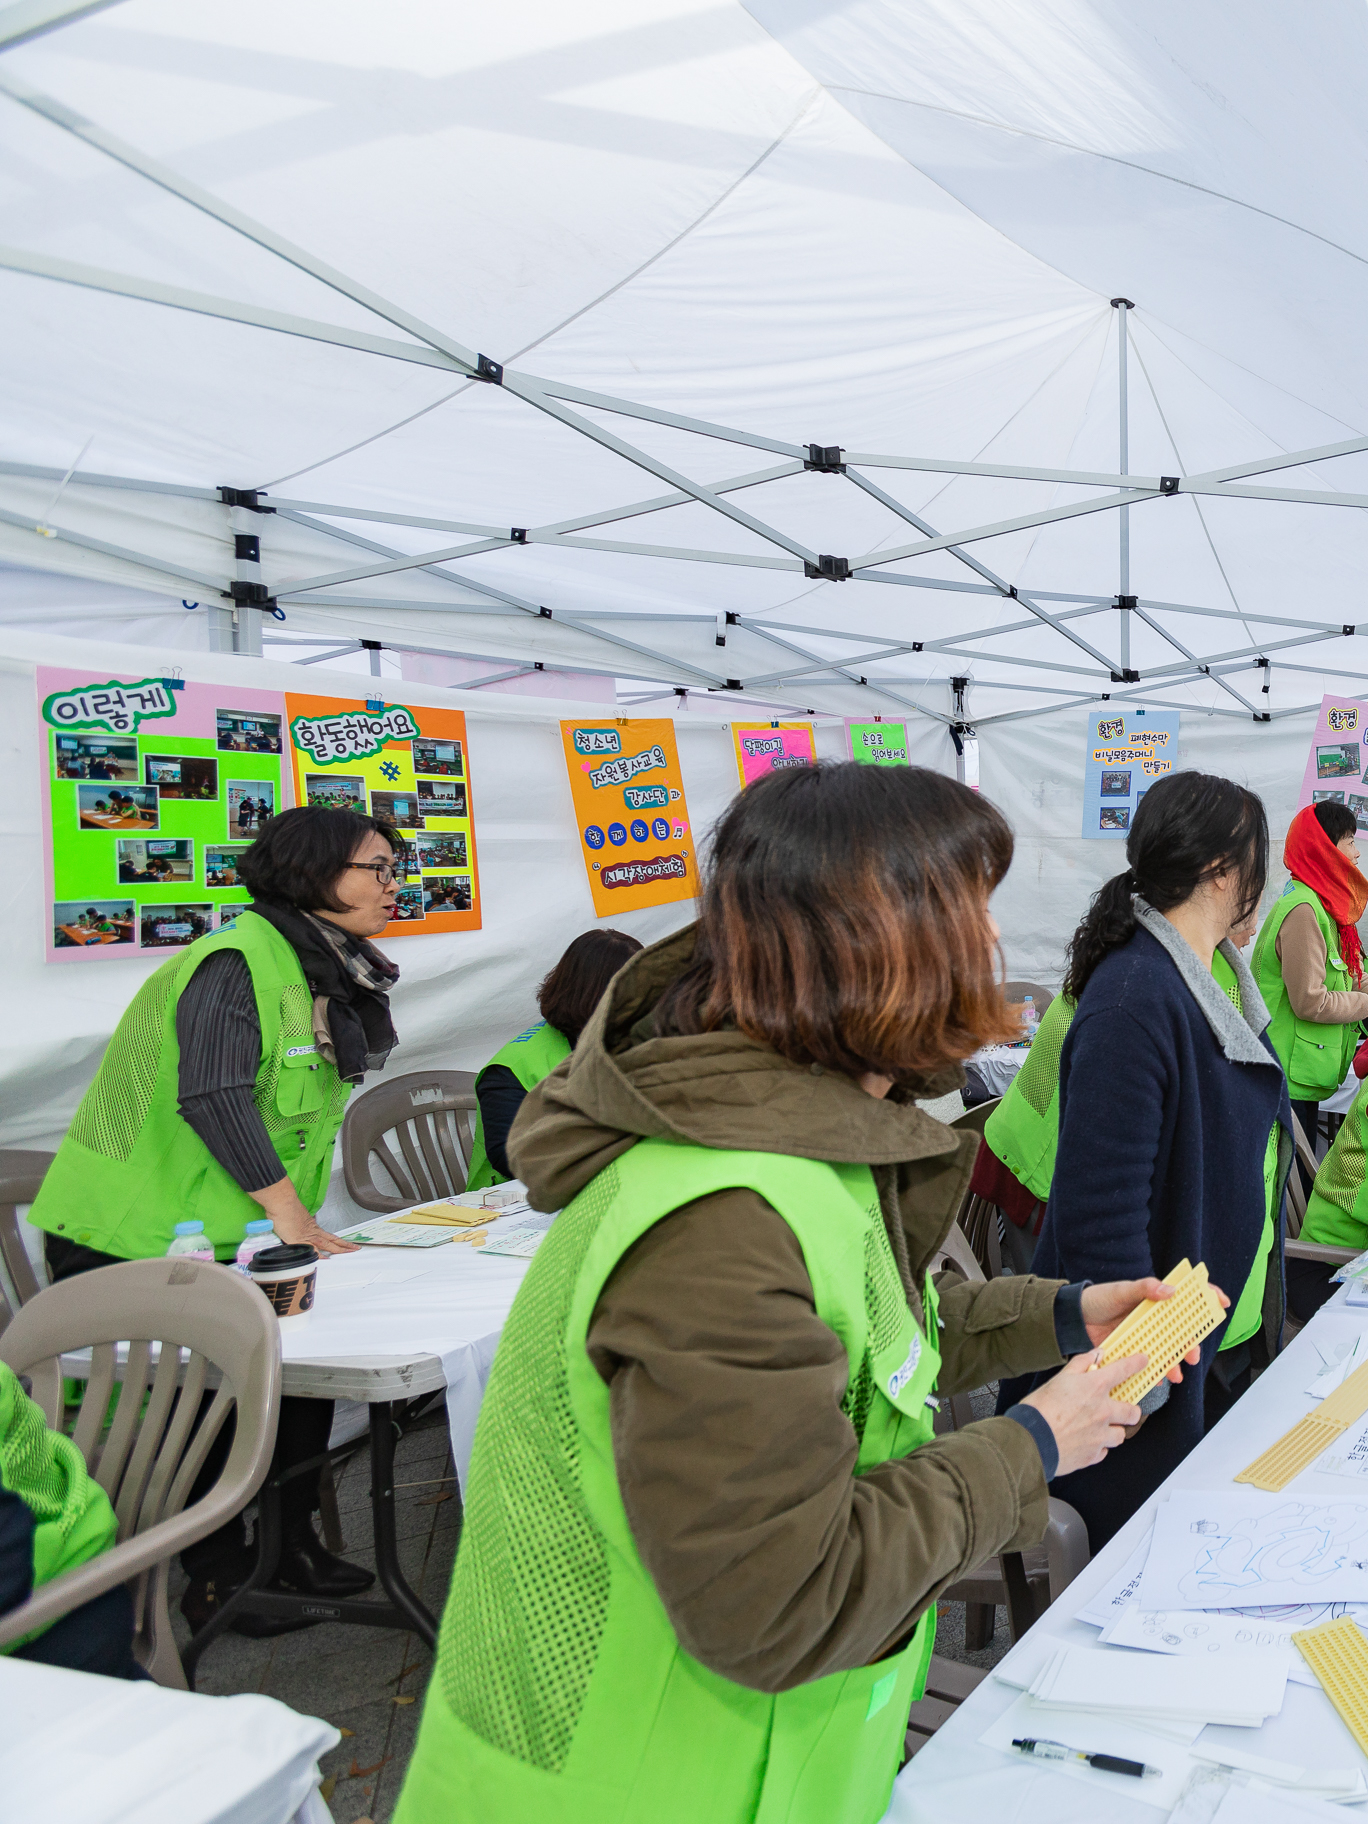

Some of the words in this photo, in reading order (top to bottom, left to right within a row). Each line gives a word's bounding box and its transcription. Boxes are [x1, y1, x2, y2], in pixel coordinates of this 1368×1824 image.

[57, 687, 166, 730] 이렇게
[1330, 710, 1356, 728] 환경
[297, 714, 414, 758] 활동했어요
[862, 731, 883, 746] 손으로
[1100, 720, 1123, 739] 환경
[577, 731, 619, 751] 청소년
[744, 737, 783, 755] 달팽이길
[1130, 733, 1168, 745] 폐현수막
[1095, 750, 1152, 762] 비닐모음주머니
[592, 747, 665, 785] 자원봉사교육
[1143, 761, 1170, 773] 만들기
[627, 789, 666, 806] 강사단
